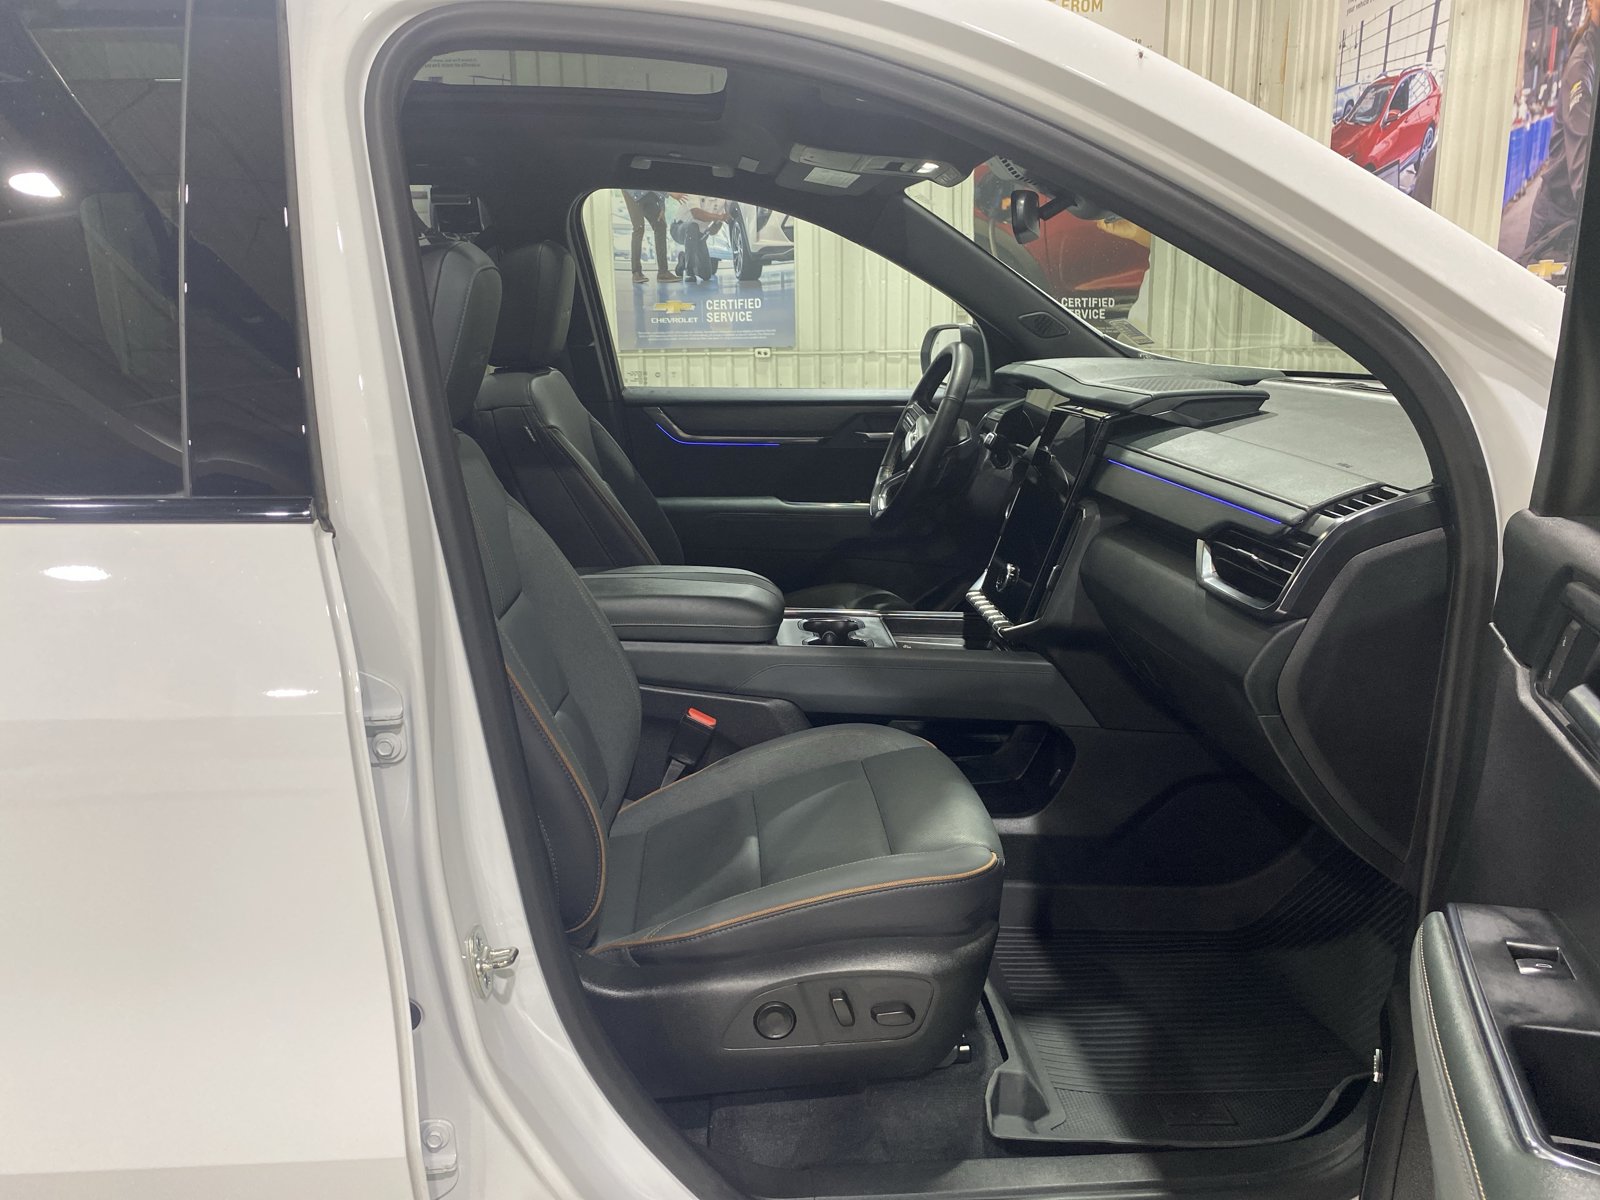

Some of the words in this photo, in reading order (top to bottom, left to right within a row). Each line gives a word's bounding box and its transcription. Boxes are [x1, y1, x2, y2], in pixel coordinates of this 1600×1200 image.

[1061, 0, 1103, 13] FROM
[705, 298, 762, 311] CERTIFIED
[1061, 297, 1115, 308] CERTIFIED
[705, 311, 753, 323] SERVICE
[1070, 308, 1106, 320] RVICE
